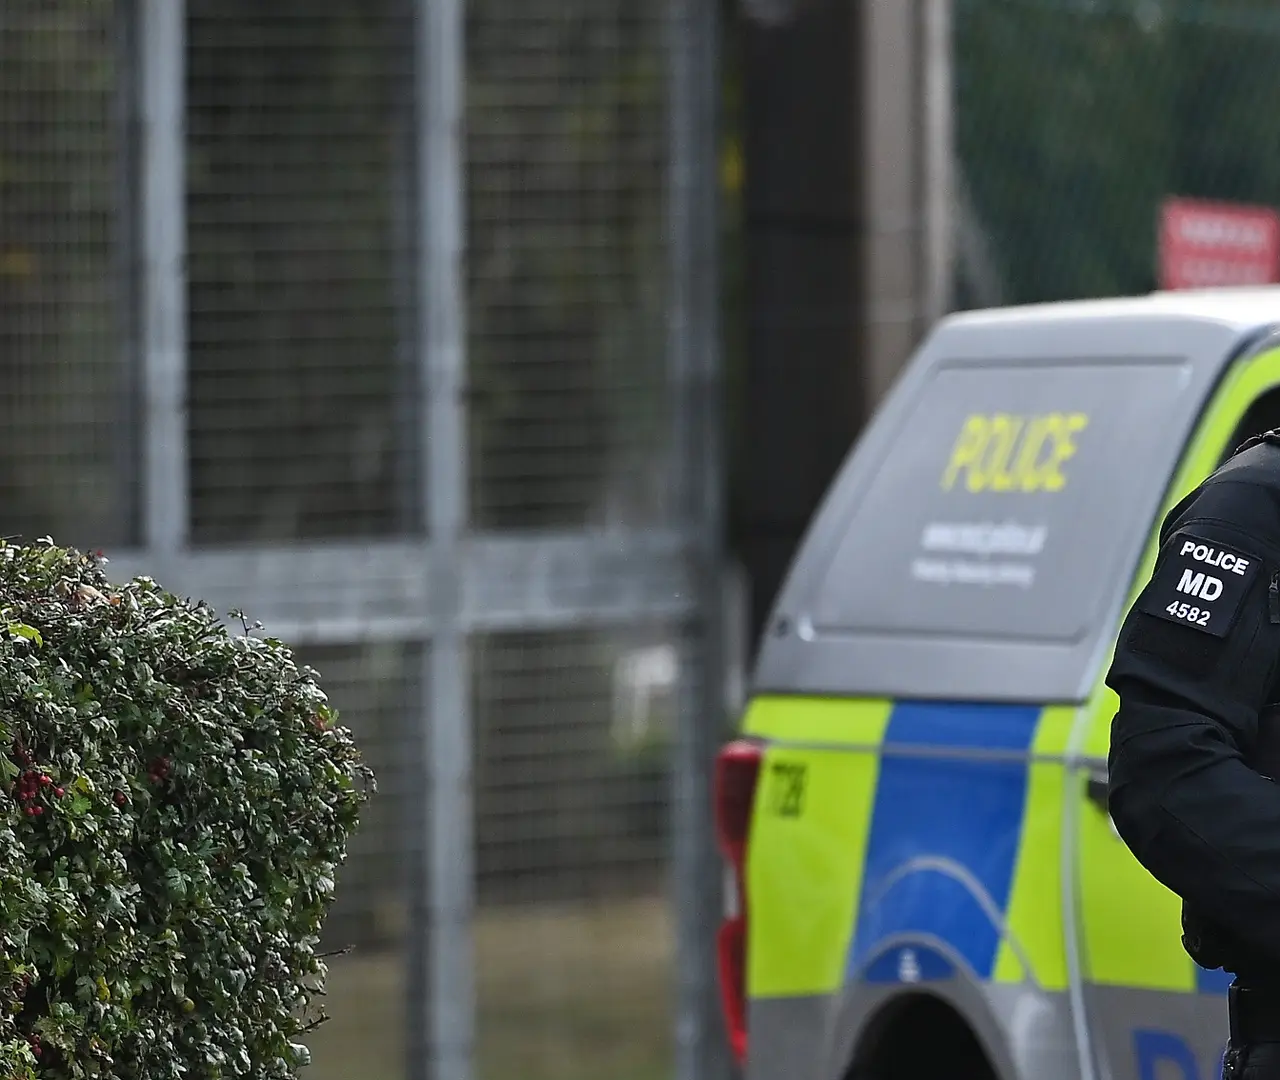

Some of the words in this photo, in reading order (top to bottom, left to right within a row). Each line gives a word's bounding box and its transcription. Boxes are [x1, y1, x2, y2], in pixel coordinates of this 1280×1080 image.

[942, 413, 1088, 493] POLICE
[1180, 541, 1250, 576] POLICE
[1176, 568, 1224, 602] MD
[1165, 600, 1211, 627] 4582
